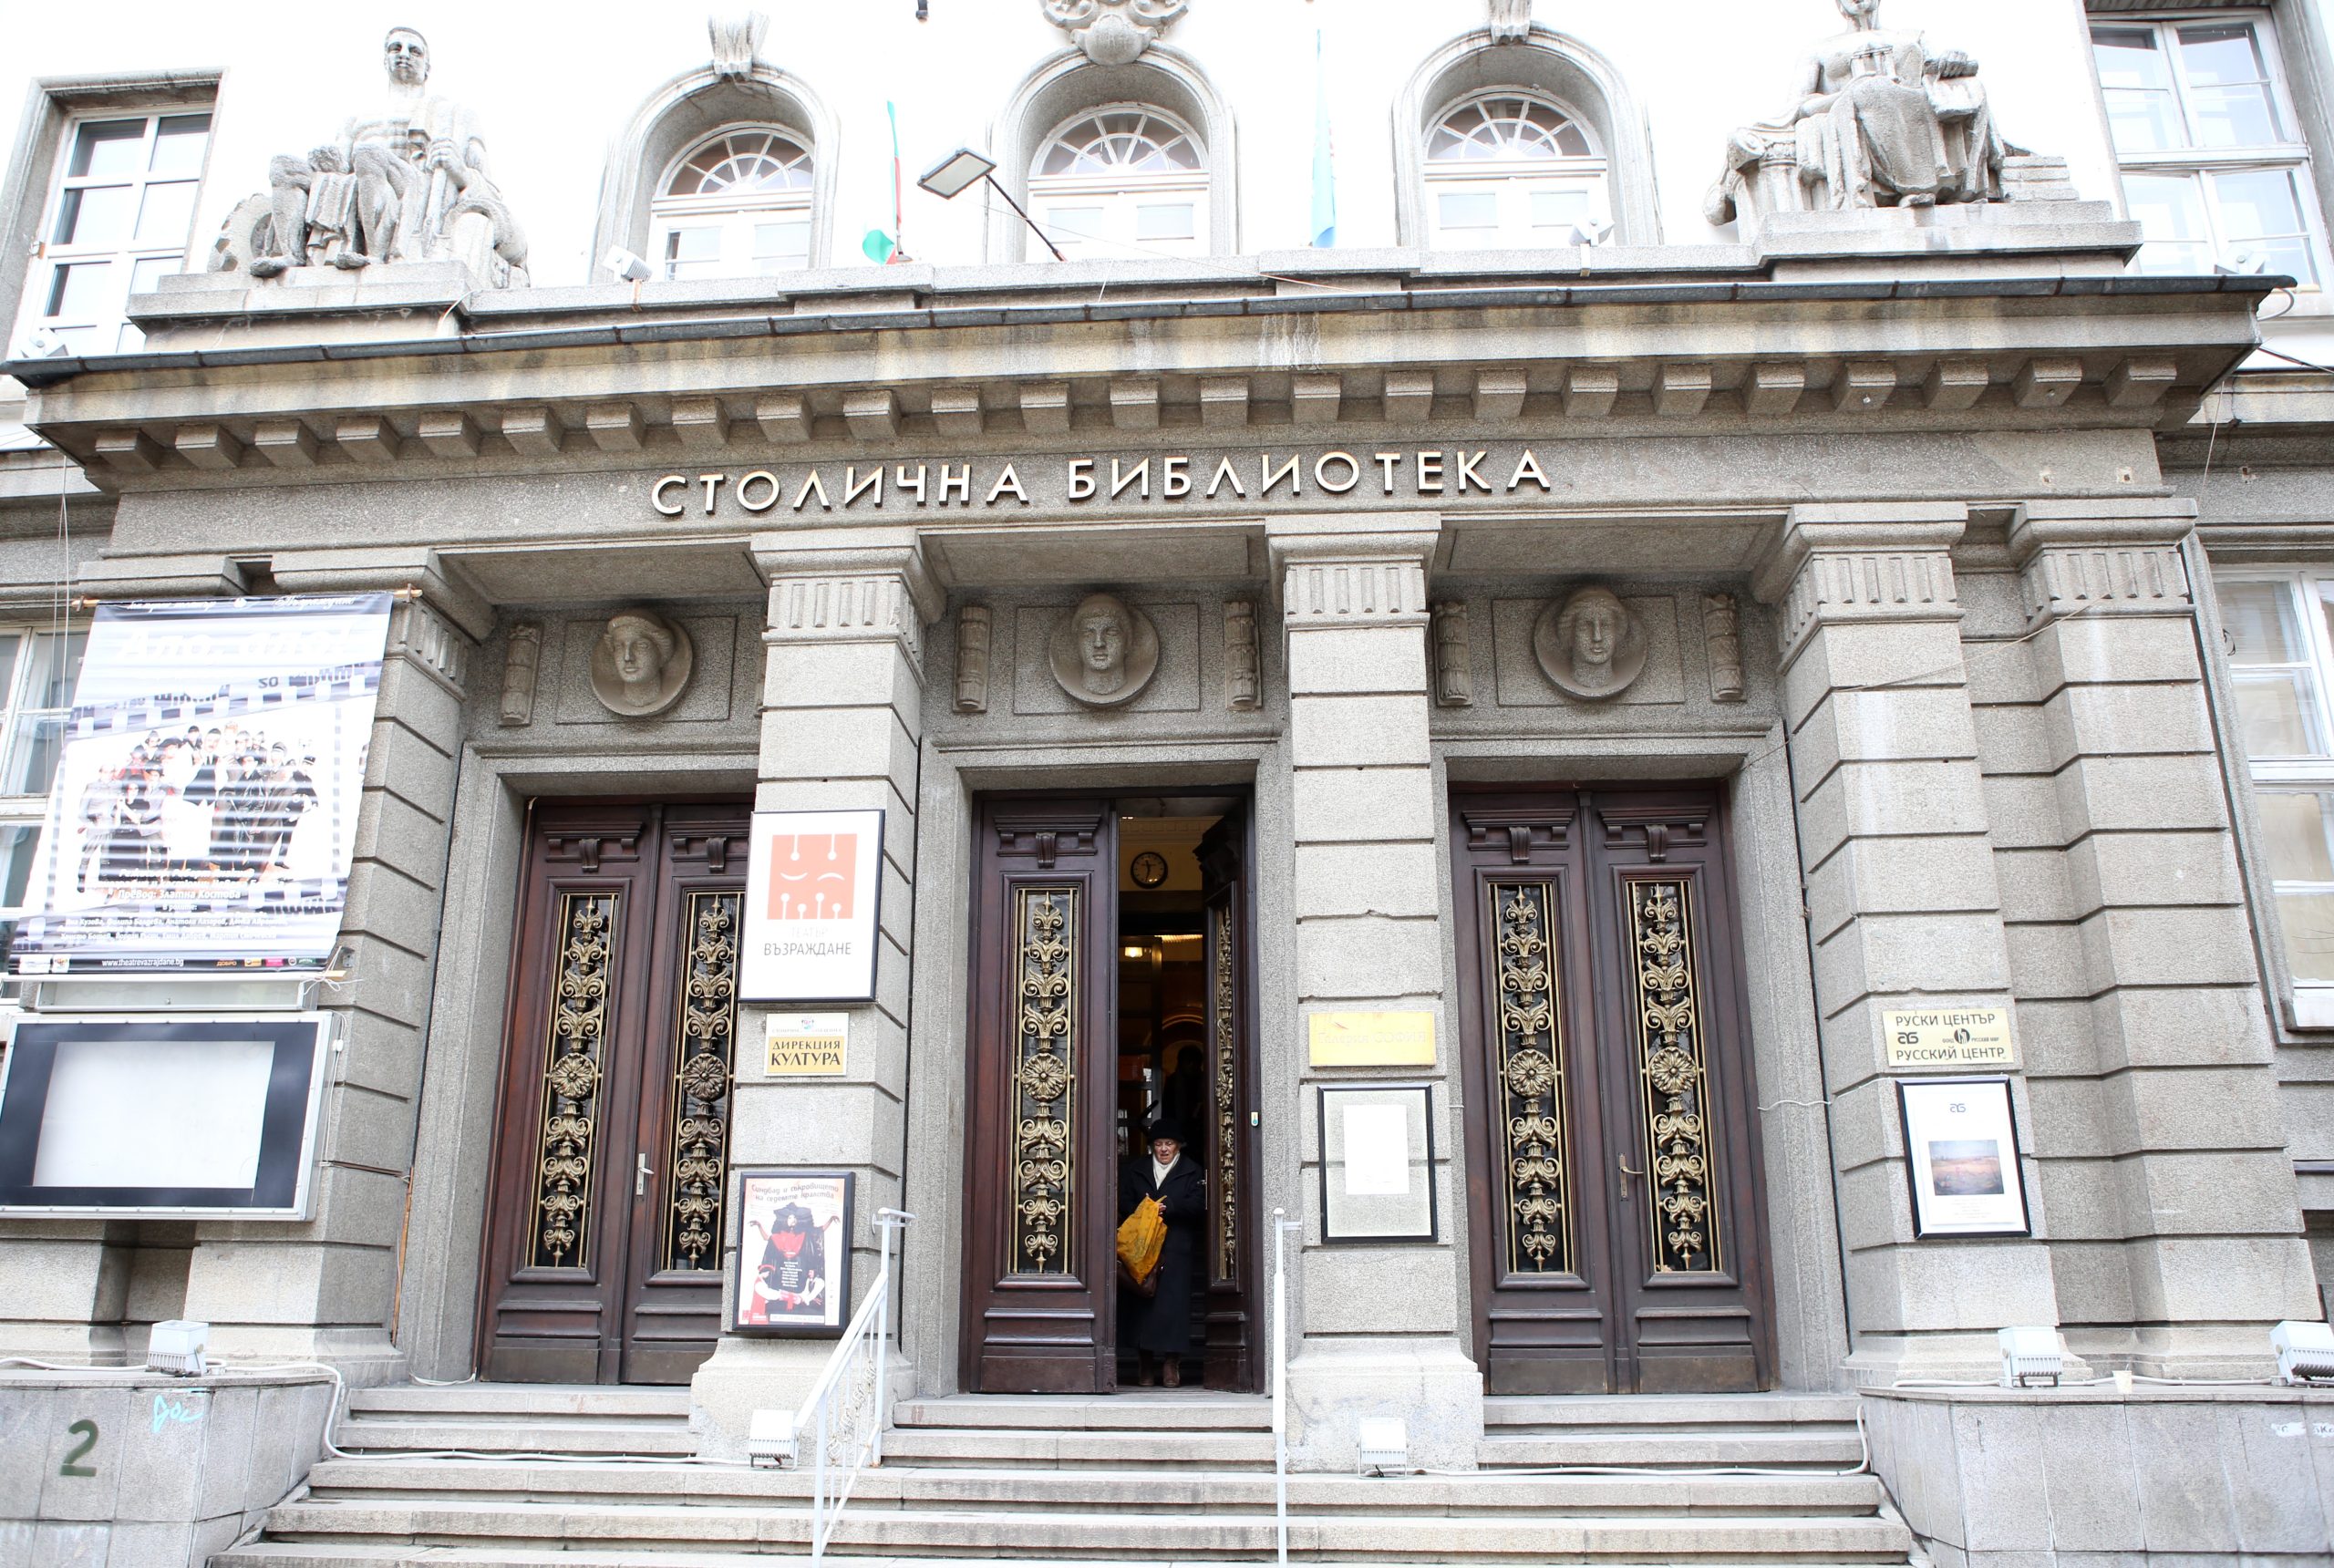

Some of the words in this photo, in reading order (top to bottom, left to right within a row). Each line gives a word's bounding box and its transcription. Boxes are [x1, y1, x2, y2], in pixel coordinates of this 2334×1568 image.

[651, 461, 1029, 517] СТОЛИЧНА
[1069, 448, 1551, 501] БИБЛИОТЕКА
[763, 942, 852, 957] ВЪЗРАЖДАНЕ
[1895, 1015, 1938, 1026] РУСКИ
[1943, 1013, 1996, 1027] ЦЕНТЪР
[772, 1040, 841, 1050] ДИРЕКЦИЯ
[770, 1052, 841, 1066] КУЛТУРА
[1896, 1046, 1957, 1061] РУССКИЙ
[1961, 1047, 2005, 1060] ЦЕНТР
[60, 1418, 98, 1477] 2
